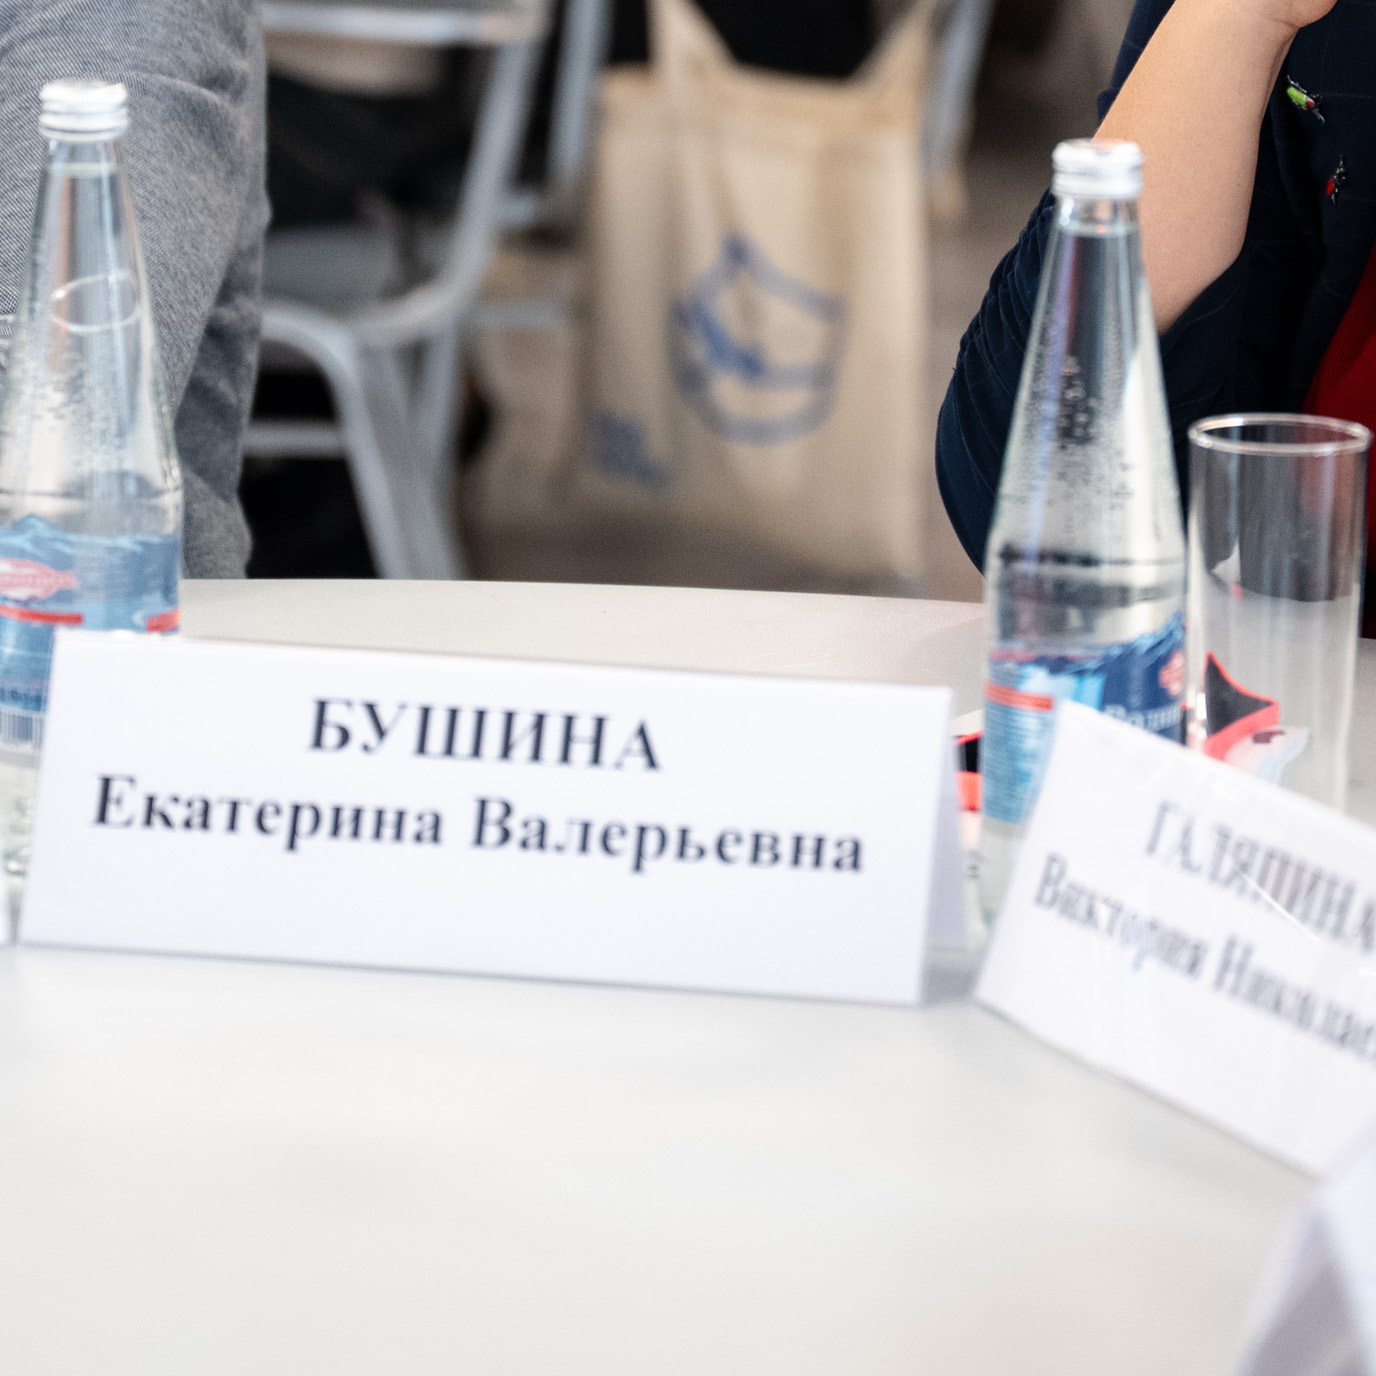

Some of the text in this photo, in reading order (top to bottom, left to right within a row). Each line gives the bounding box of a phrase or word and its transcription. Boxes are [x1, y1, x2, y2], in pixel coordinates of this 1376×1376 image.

[308, 697, 664, 773] БУШИНА
[91, 772, 867, 876] Екатерина Валерьевна
[1032, 851, 1211, 978] Виктория
